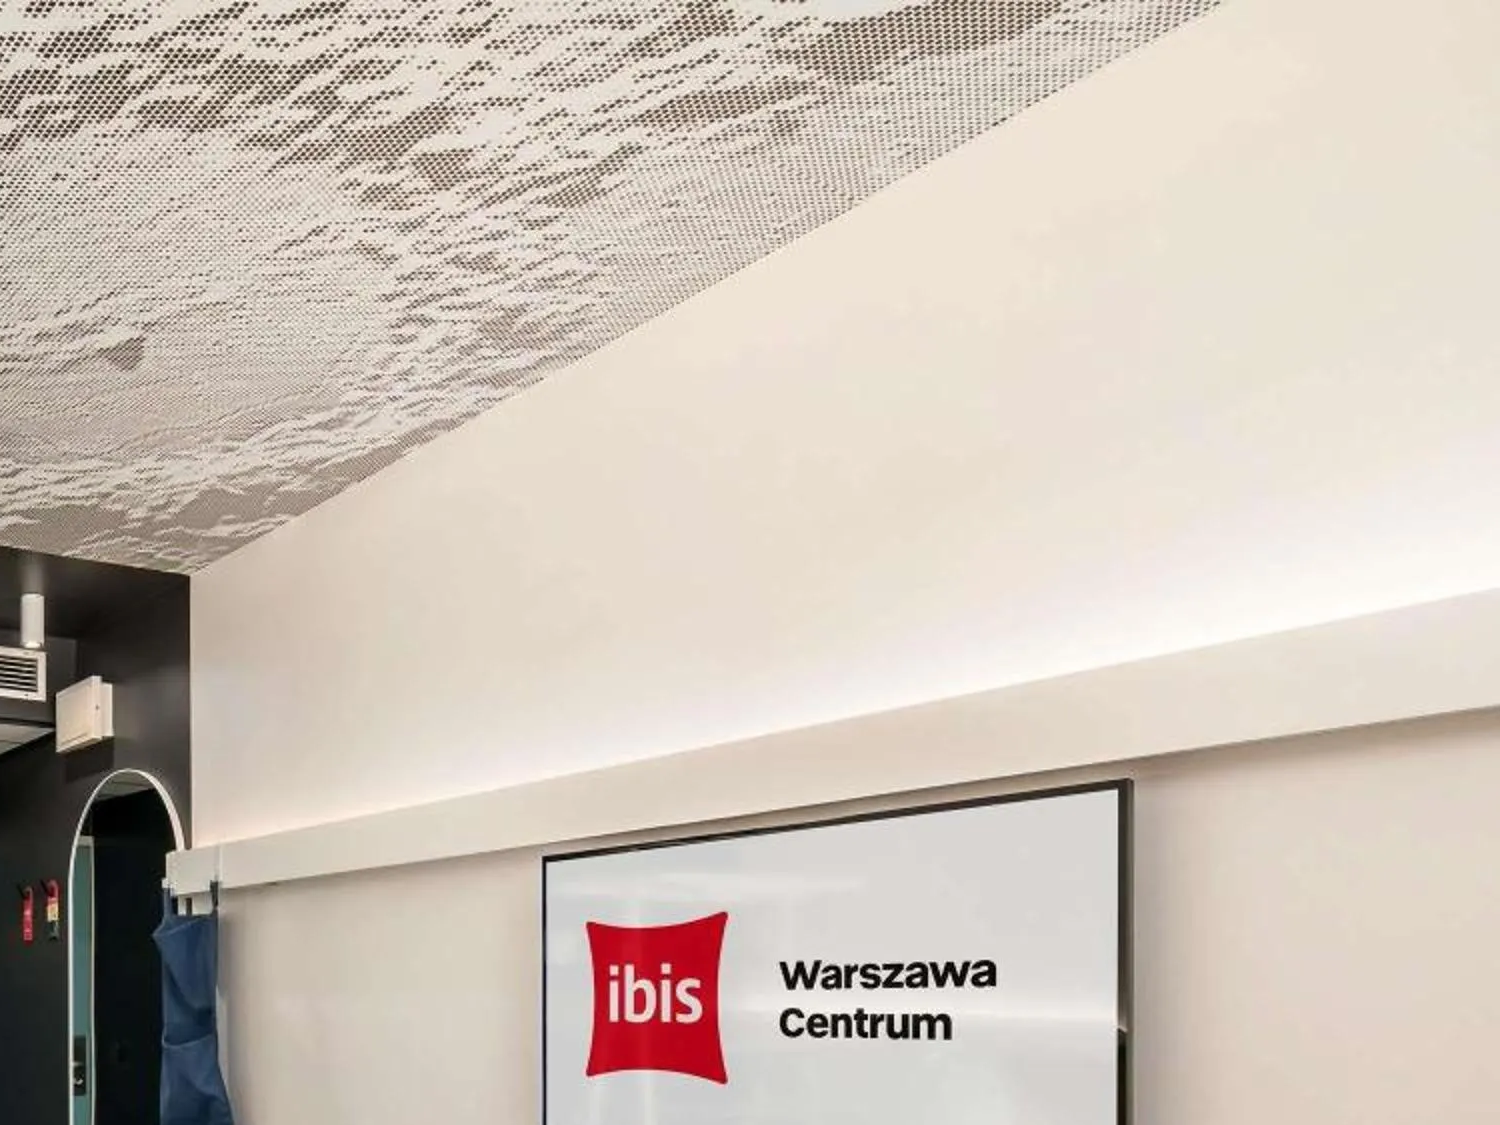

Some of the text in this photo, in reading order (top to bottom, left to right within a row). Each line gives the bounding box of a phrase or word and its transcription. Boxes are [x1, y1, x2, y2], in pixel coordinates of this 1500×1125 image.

[779, 959, 997, 991] Warszawa
[608, 963, 703, 1025] ibis
[779, 1007, 952, 1041] Centrum
